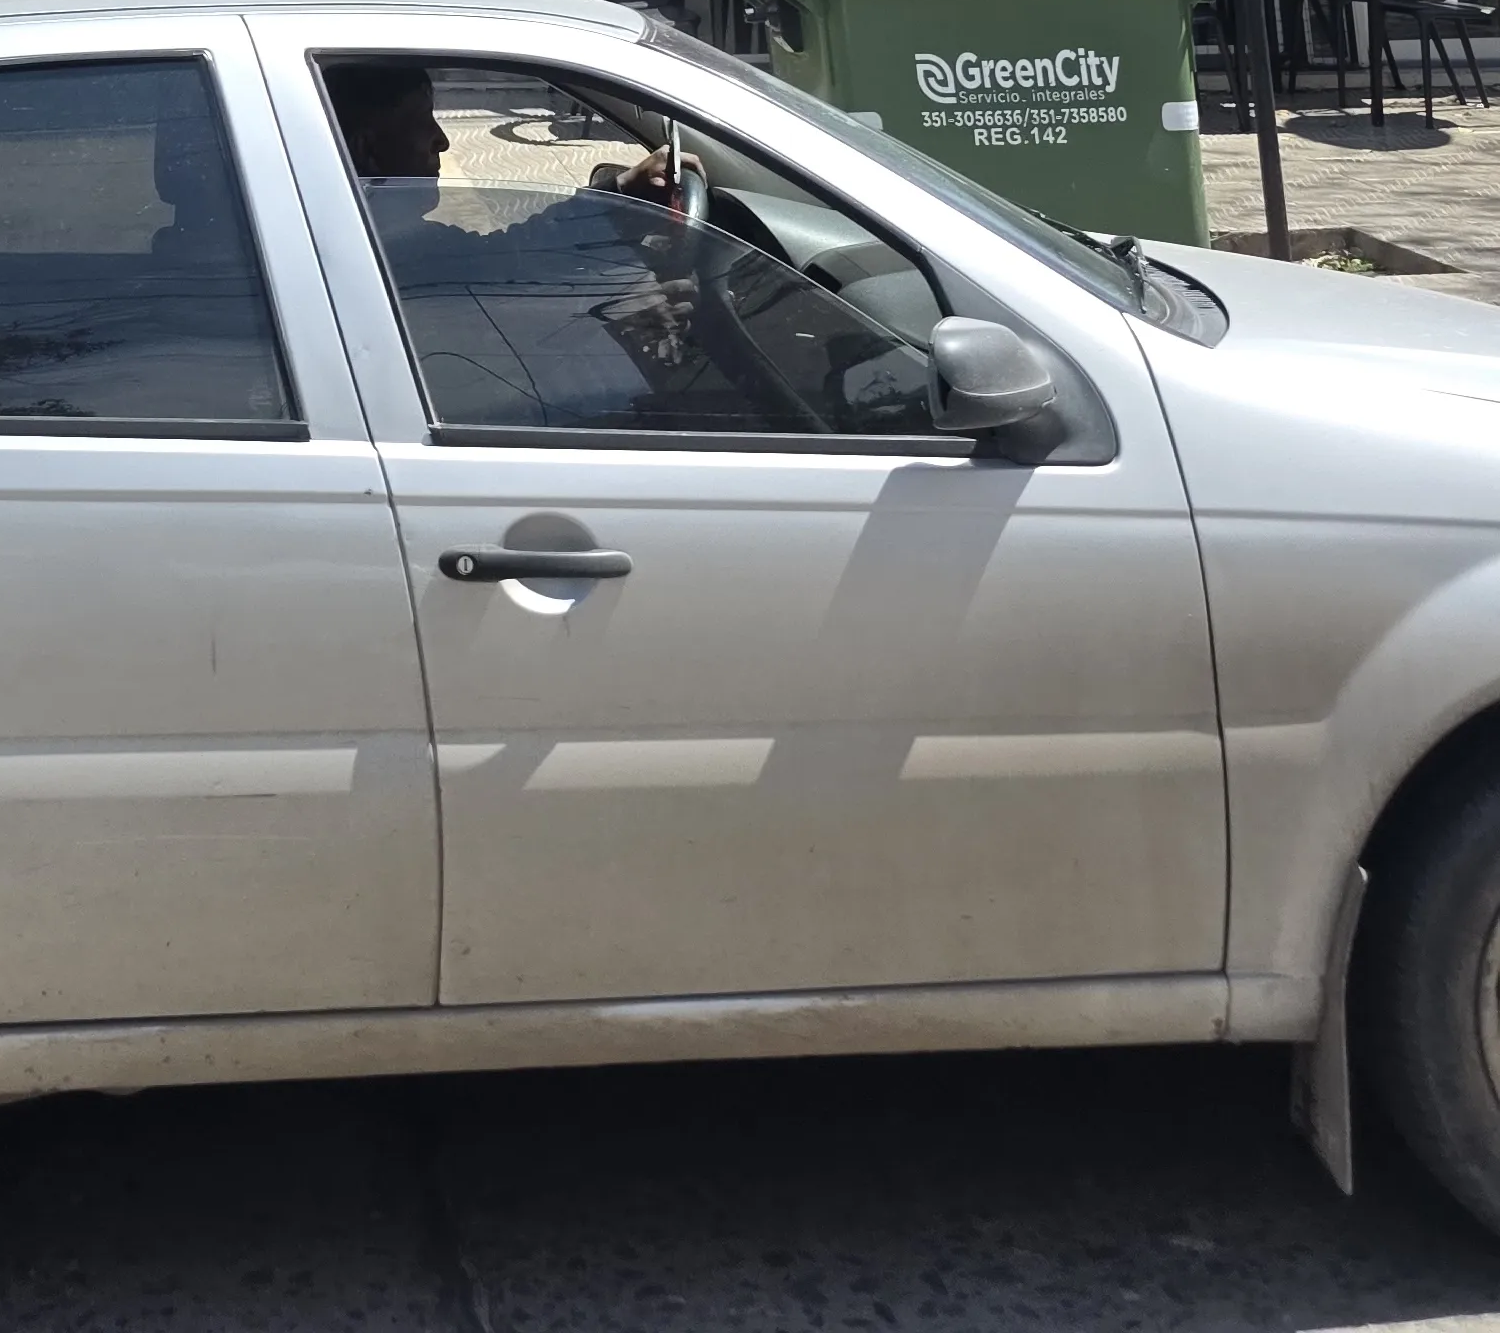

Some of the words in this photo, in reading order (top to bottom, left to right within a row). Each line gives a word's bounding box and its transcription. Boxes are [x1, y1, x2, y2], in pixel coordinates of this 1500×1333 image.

[955, 48, 1120, 93] GreenCity
[1031, 88, 1105, 104] integrales
[921, 106, 1128, 128] 351-3056636/351-7358580
[973, 126, 1068, 146] REG.142
